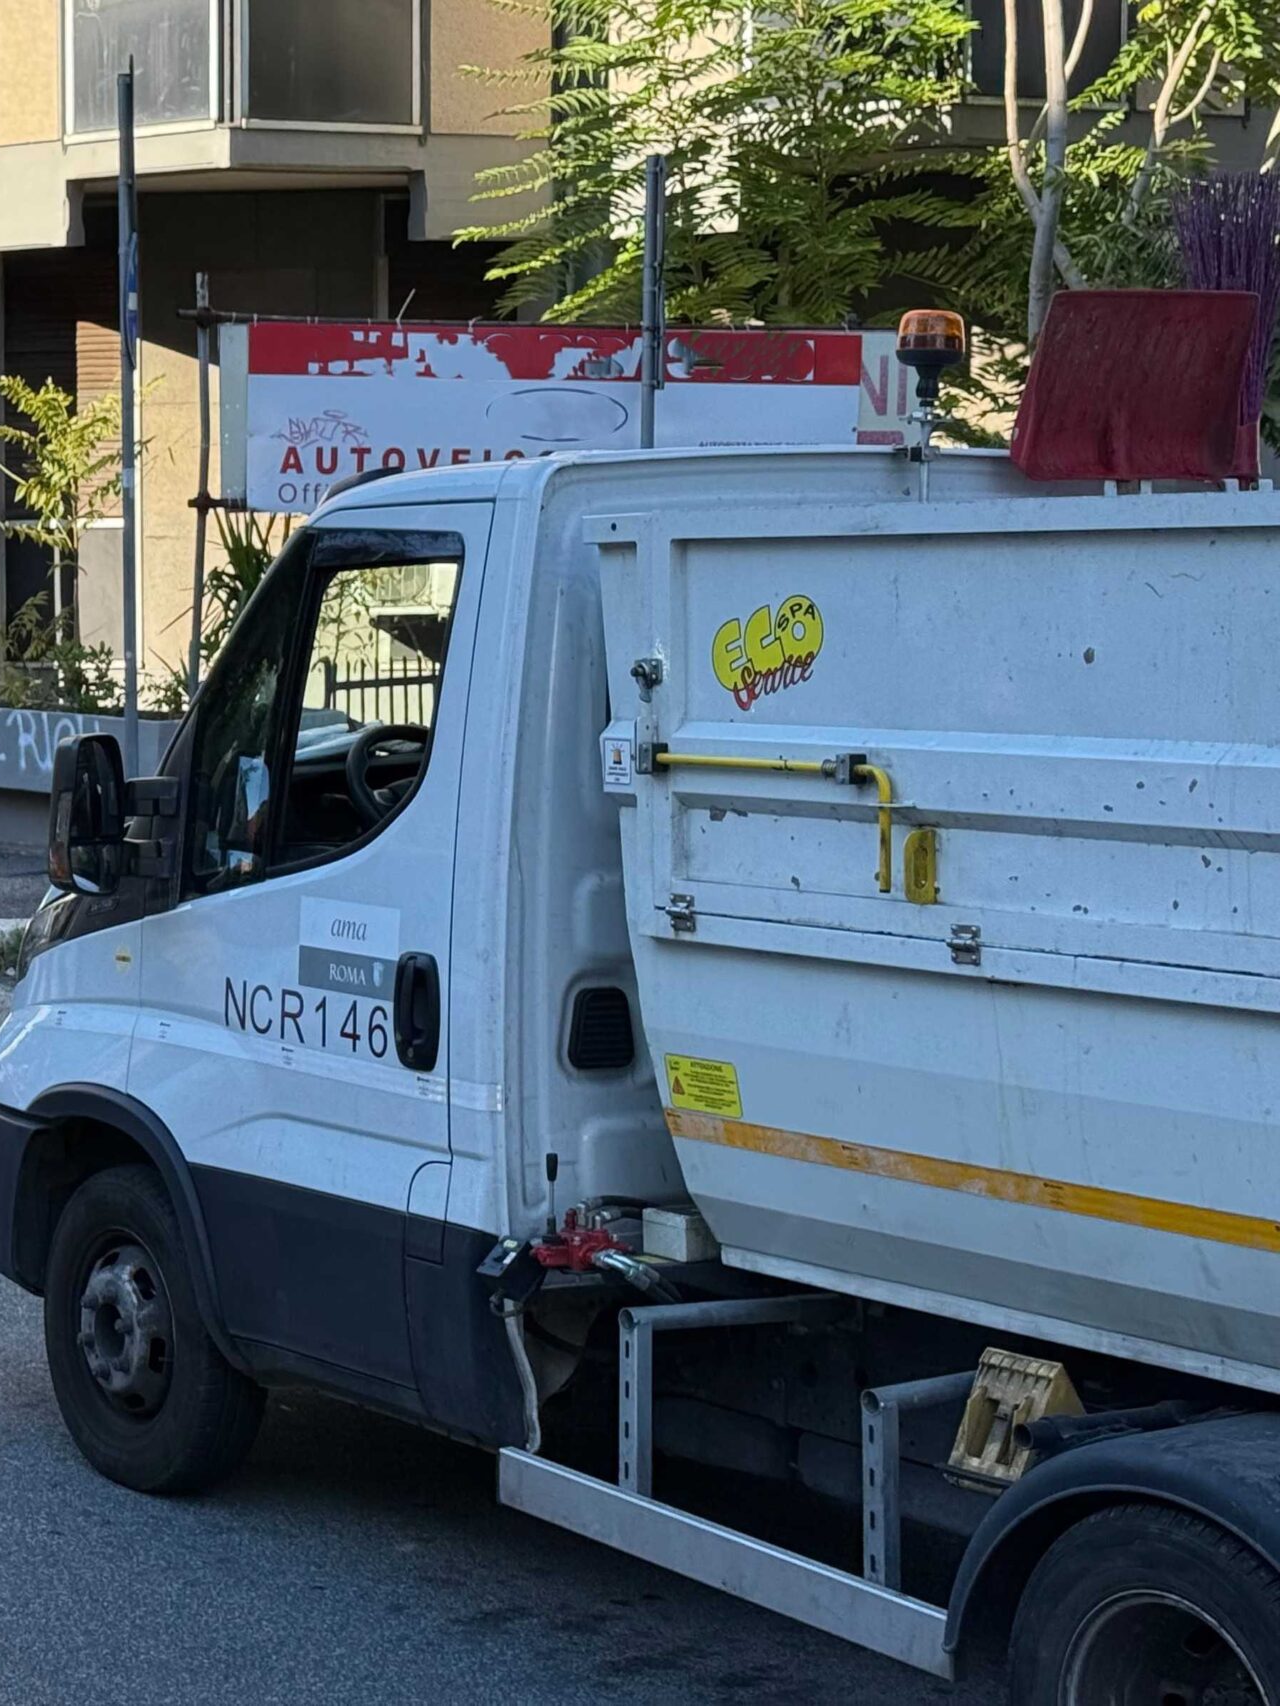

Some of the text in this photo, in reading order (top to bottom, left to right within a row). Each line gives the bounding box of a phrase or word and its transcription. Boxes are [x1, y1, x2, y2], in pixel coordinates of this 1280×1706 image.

[280, 446, 554, 475] AUTOVE
[278, 483, 329, 504] Off
[777, 603, 816, 633] SPA
[711, 594, 824, 692] ECO
[6, 711, 100, 769] RI
[330, 917, 368, 942] ama
[329, 963, 367, 985] ROMA
[224, 976, 389, 1058] NCR146
